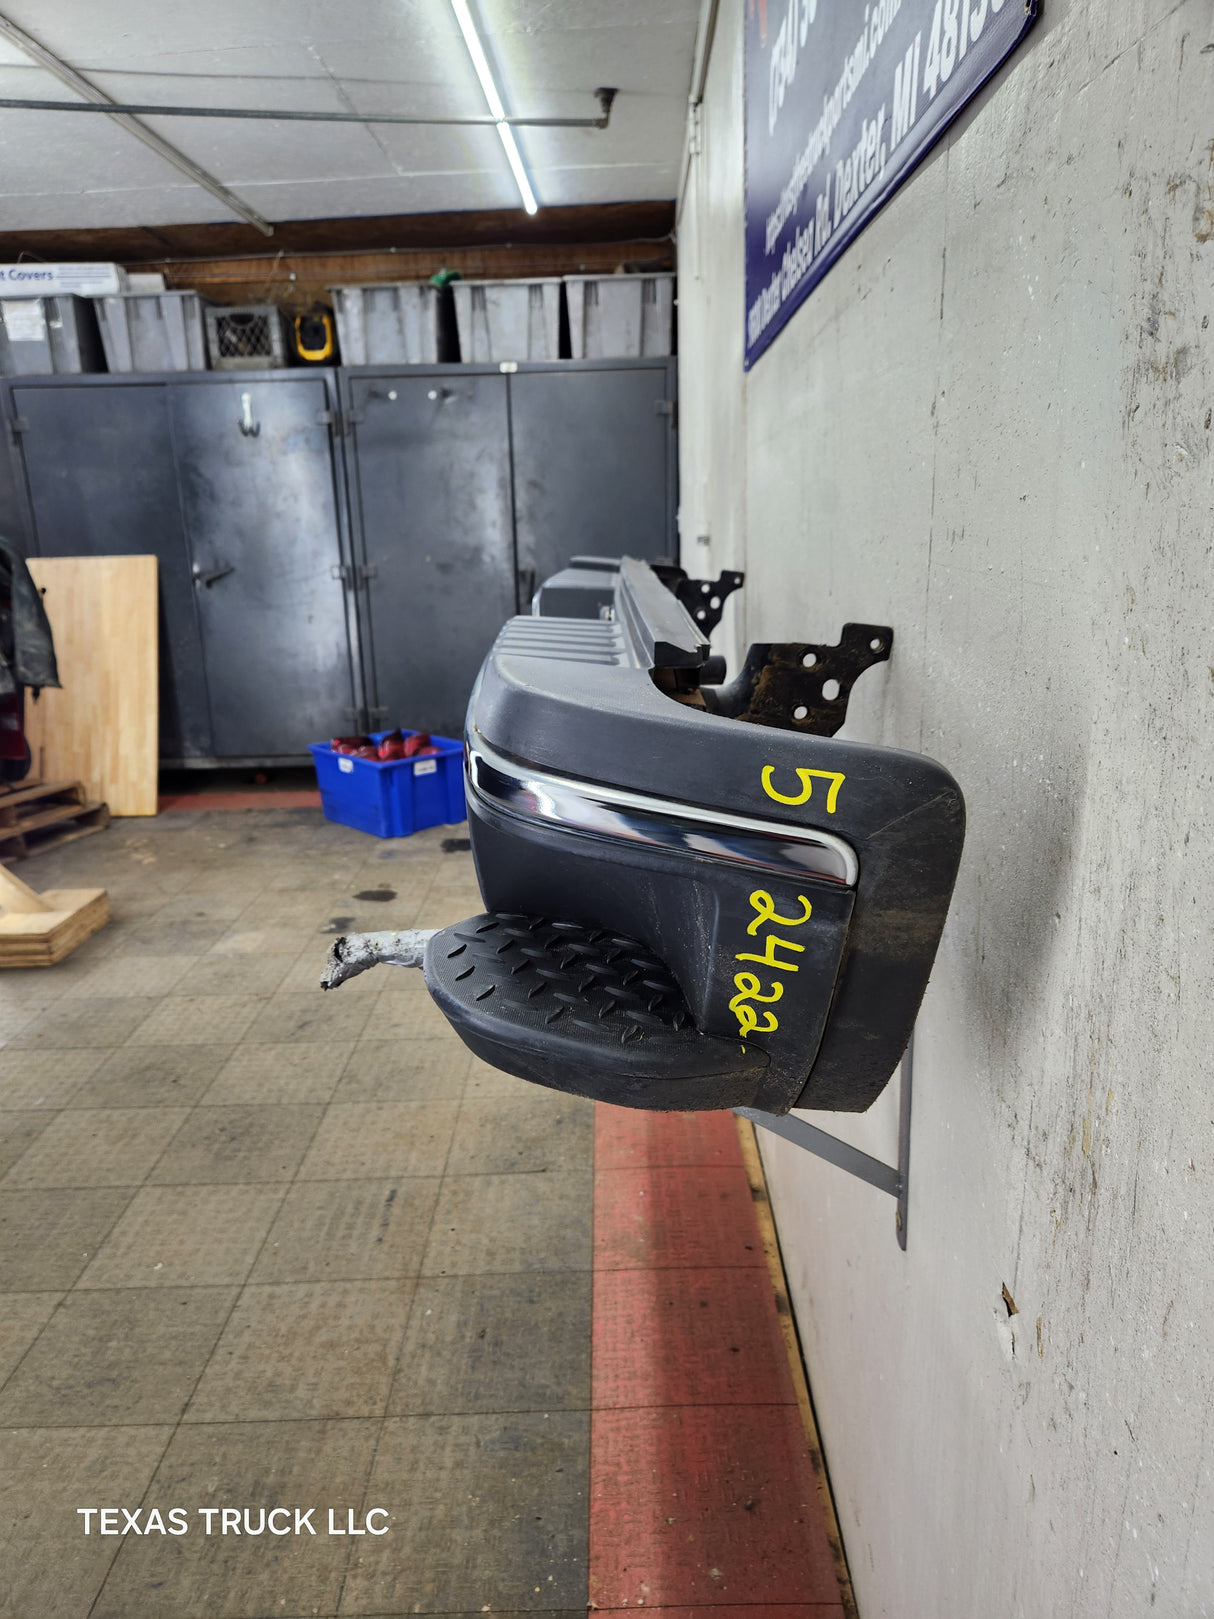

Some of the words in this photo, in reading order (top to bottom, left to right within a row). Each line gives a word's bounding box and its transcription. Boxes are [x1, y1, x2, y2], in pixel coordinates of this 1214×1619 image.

[834, 102, 886, 230] Dexter,
[890, 30, 921, 151] MI
[8, 268, 54, 281] Covers
[761, 765, 846, 814] 5
[729, 889, 813, 1038] 2422
